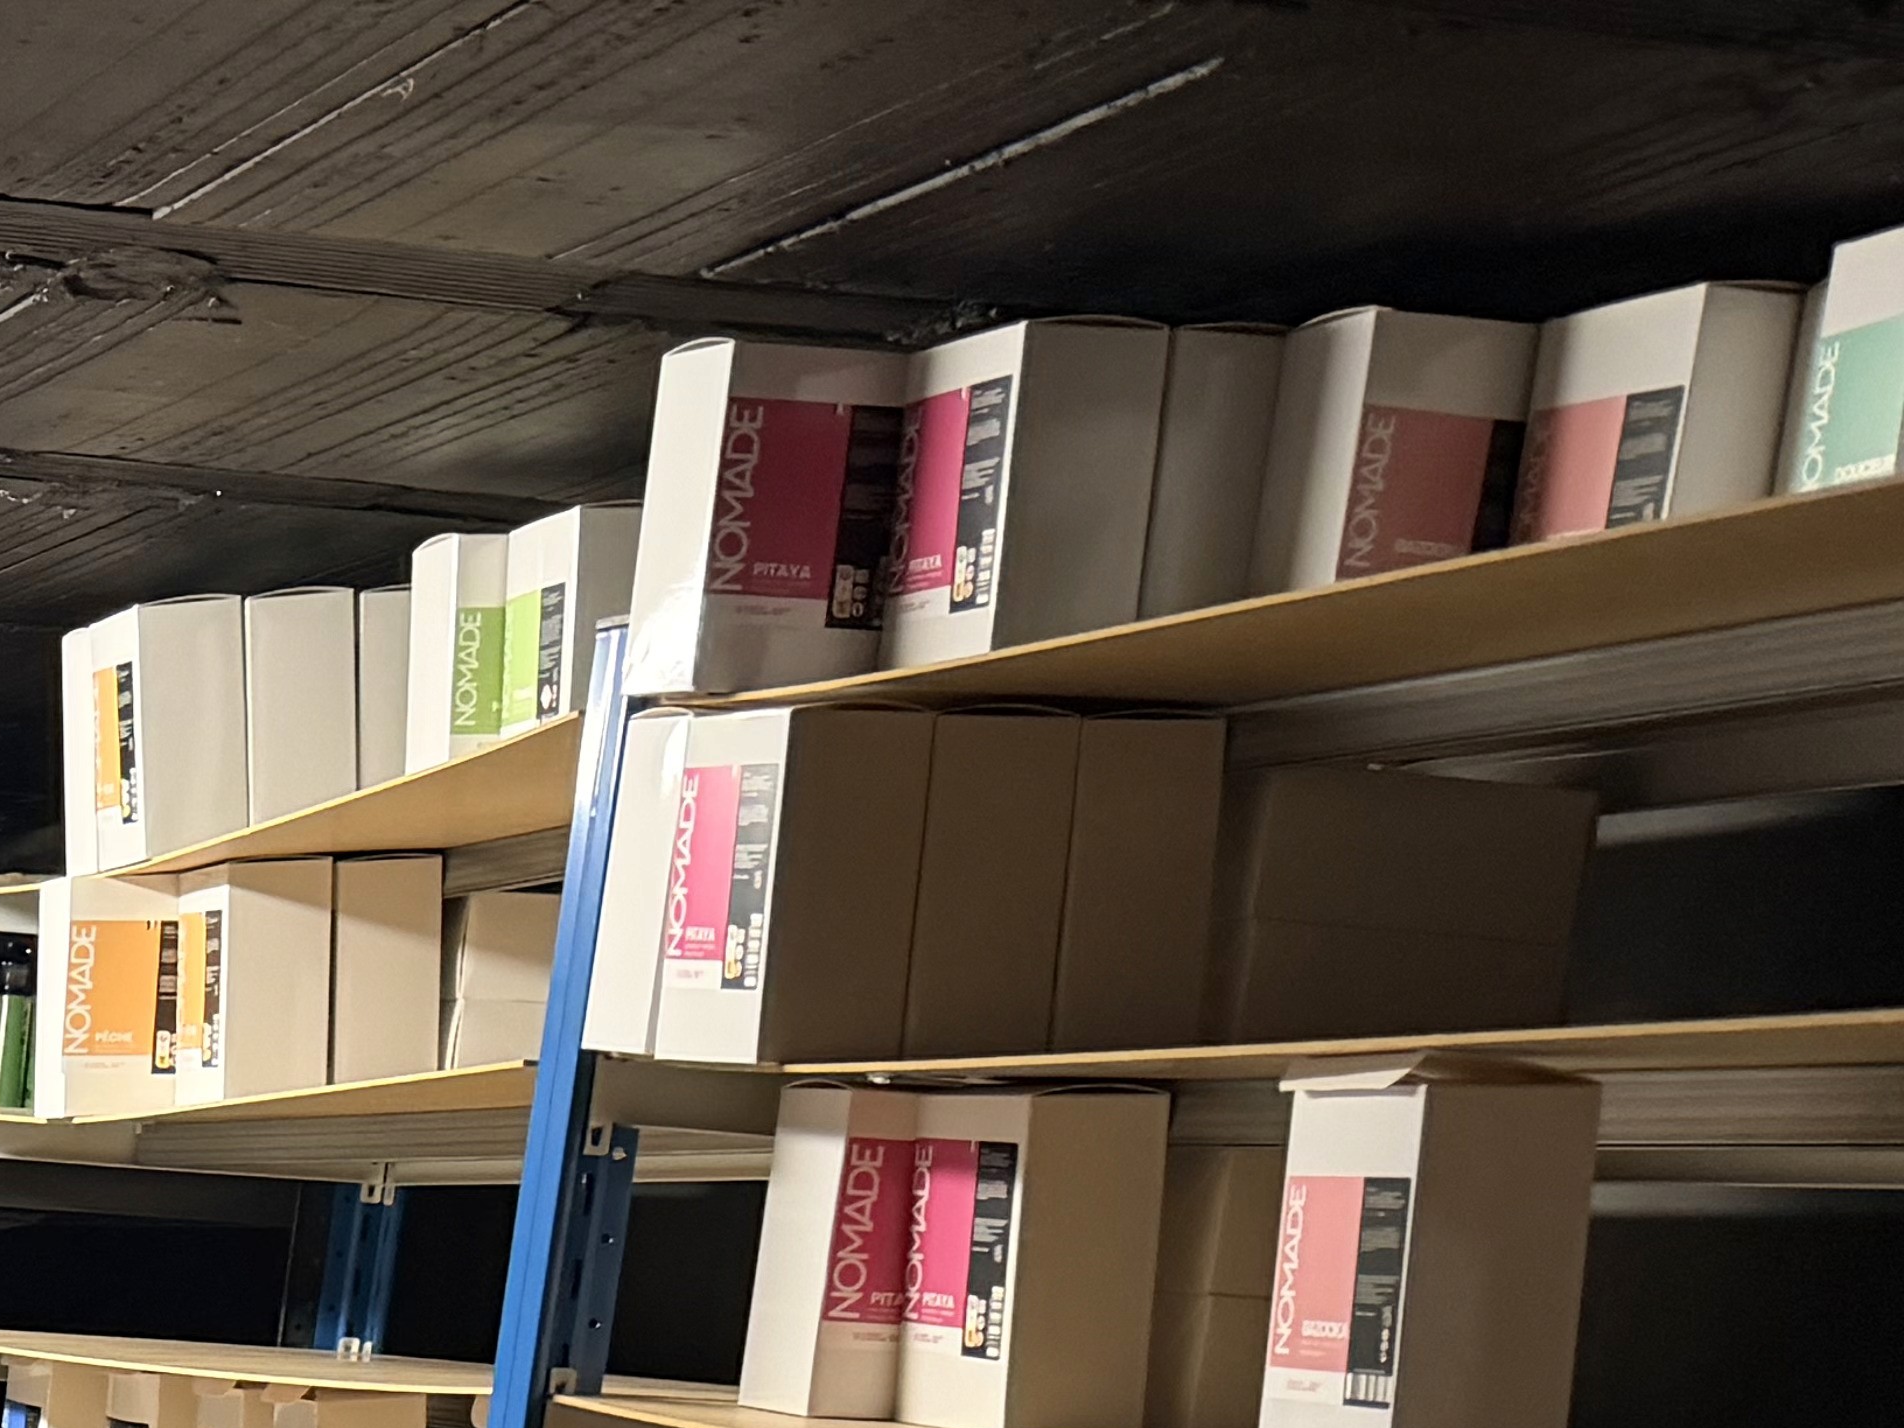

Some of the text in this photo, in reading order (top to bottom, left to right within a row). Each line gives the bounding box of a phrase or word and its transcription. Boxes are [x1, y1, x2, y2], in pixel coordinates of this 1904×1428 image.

[712, 404, 764, 592] NOMADE
[753, 561, 811, 580] PITAYA
[1342, 412, 1396, 568] NOMADE
[455, 610, 482, 727] NOMADE
[666, 775, 700, 957] NOMADE
[65, 925, 96, 1054] NOMADE
[830, 1143, 886, 1319] NOMADE
[902, 1143, 936, 1319] NOMADE
[1274, 1184, 1308, 1355] NOMADE
